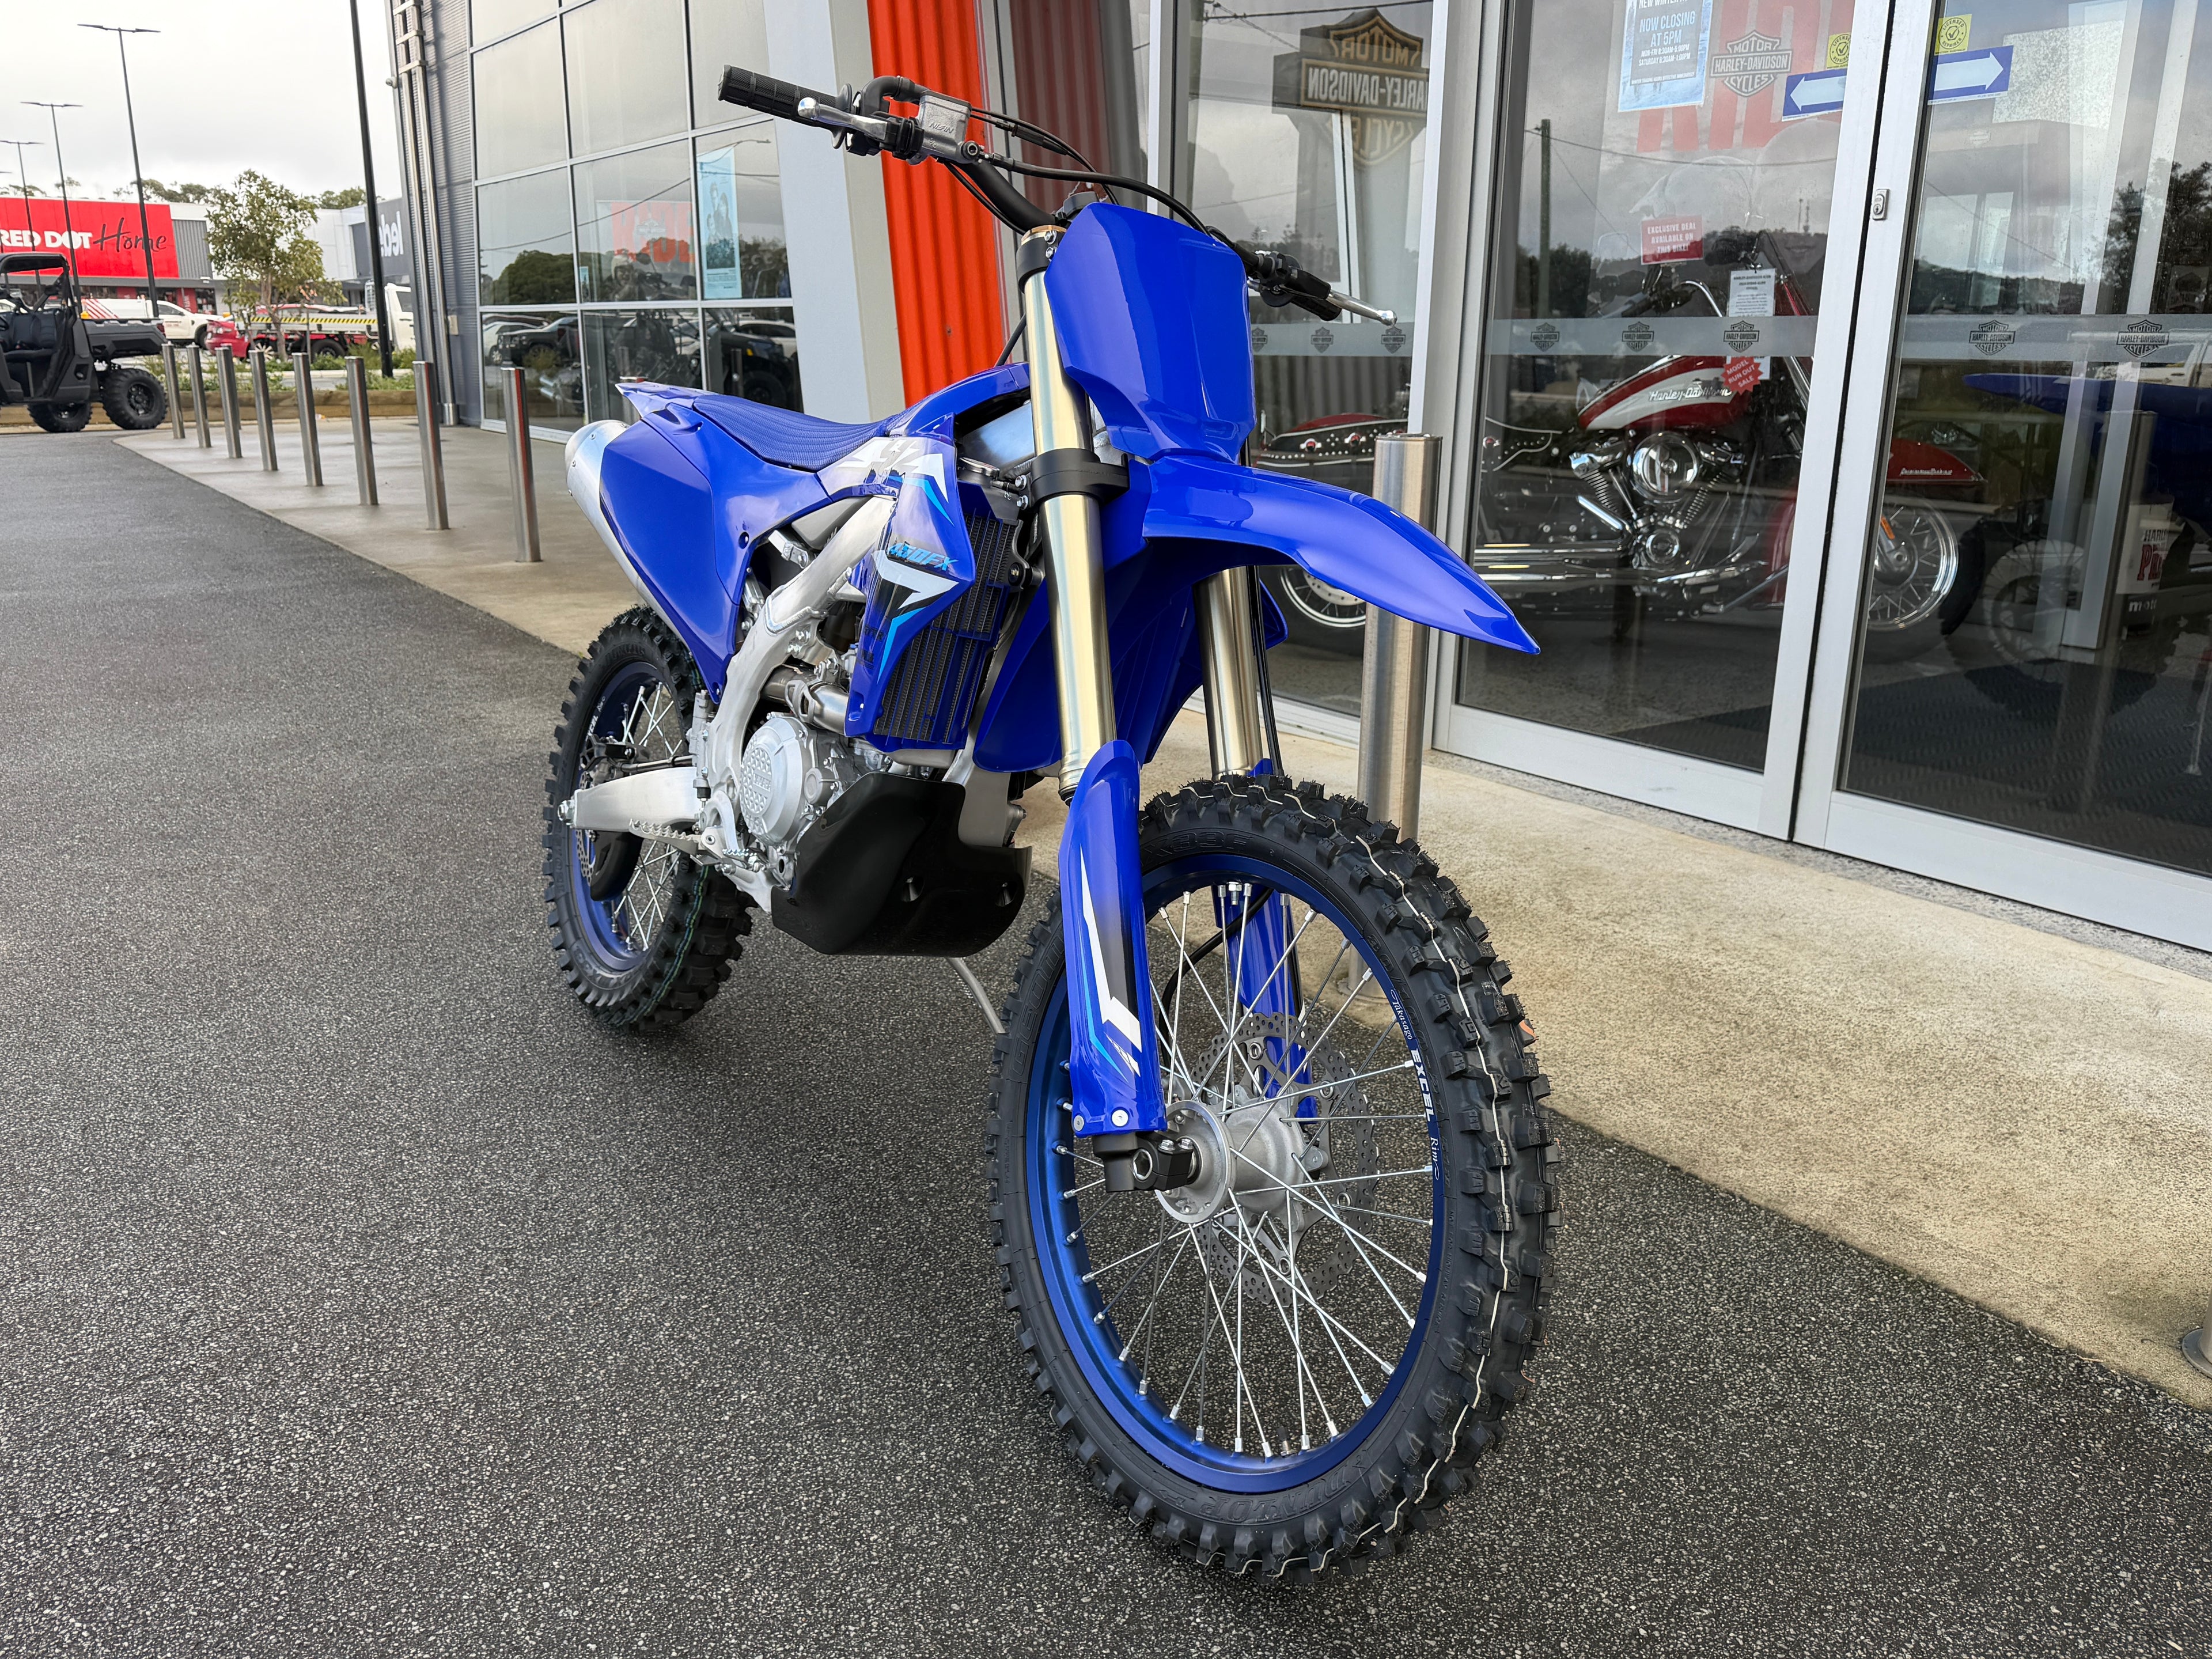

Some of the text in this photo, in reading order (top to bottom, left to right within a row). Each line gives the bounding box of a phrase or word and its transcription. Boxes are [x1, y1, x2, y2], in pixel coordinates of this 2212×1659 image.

[1639, 10, 1696, 33] NOW CLOSING
[1942, 20, 1964, 30] LICENSED
[1650, 29, 1682, 47] AT 5PM
[1733, 36, 1773, 53] MOTOR
[1832, 36, 1851, 46] LICENSE
[1942, 38, 1962, 47] REPAIRER
[1641, 48, 1658, 58] MON-FRI
[1638, 57, 1659, 66] SATURDAY
[1714, 54, 1788, 73] HARLEY-DAVIDSON
[1729, 74, 1769, 92] CYCLES
[44, 230, 93, 249] DOT
[93, 217, 166, 252] Home
[1647, 222, 1696, 234] EXCLUSIVE DEAL
[1651, 233, 1694, 244] AVAILABLE ON
[1657, 245, 1671, 253] THIS
[2132, 323, 2157, 332] MOTOR
[1726, 359, 1749, 375] MODEL
[1728, 364, 1755, 384] RUN OUT
[1738, 374, 1754, 388] SALE
[1390, 989, 1413, 1040] Takasago
[1411, 1047, 1435, 1122] EXCEL
[1198, 1464, 1351, 1521] DUNLOP
